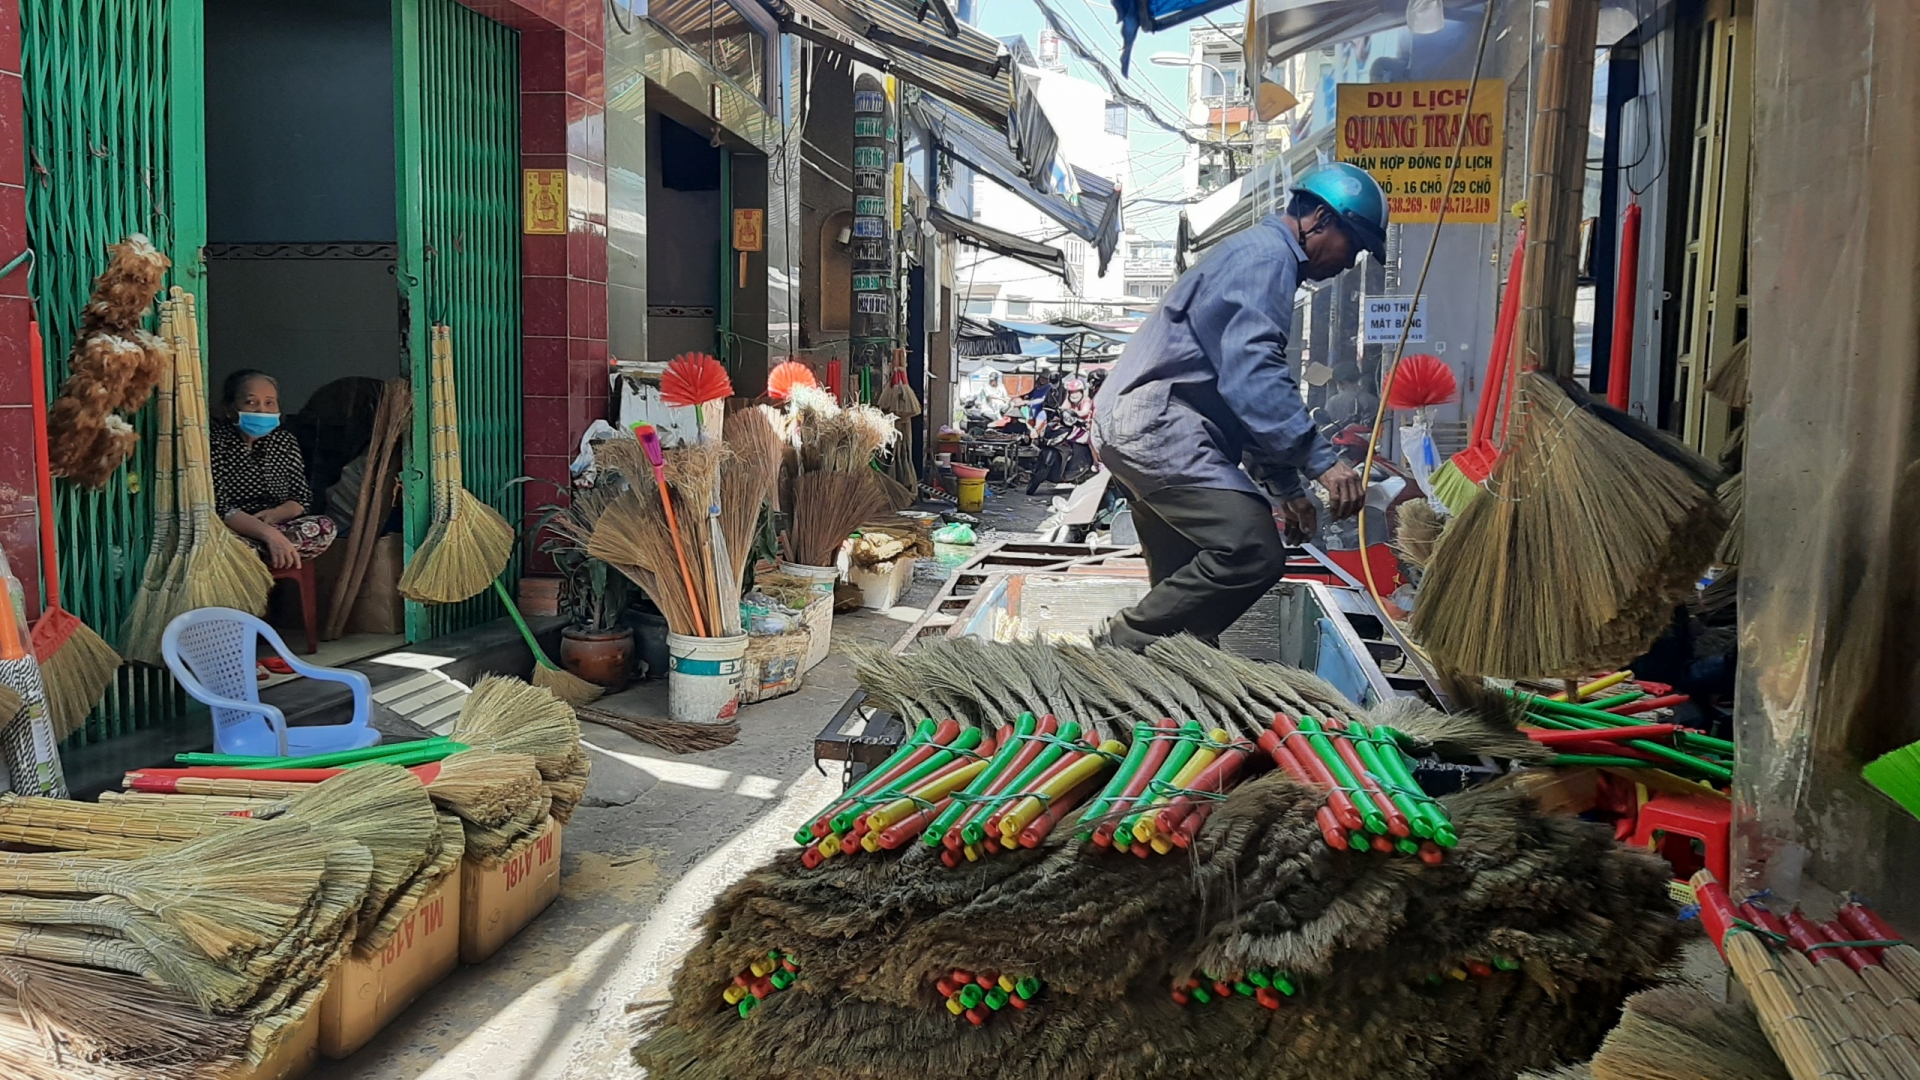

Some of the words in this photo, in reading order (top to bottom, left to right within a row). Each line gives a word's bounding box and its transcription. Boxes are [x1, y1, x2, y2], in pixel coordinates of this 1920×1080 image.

[1367, 91, 1402, 108] DU
[1412, 89, 1470, 111] LỊCH
[1345, 114, 1418, 153] QUANG
[1423, 112, 1494, 148] TRANG
[1380, 155, 1405, 172] HỢP
[1466, 156, 1493, 172] LỊCH
[1404, 181, 1416, 194] 16
[1420, 174, 1442, 194] CHỖ
[1453, 181, 1467, 194] 29
[1469, 174, 1491, 194] CHỖ
[1371, 303, 1391, 313] CHO
[536, 832, 553, 866] ML
[503, 847, 533, 892] A18L
[420, 897, 444, 936] ML
